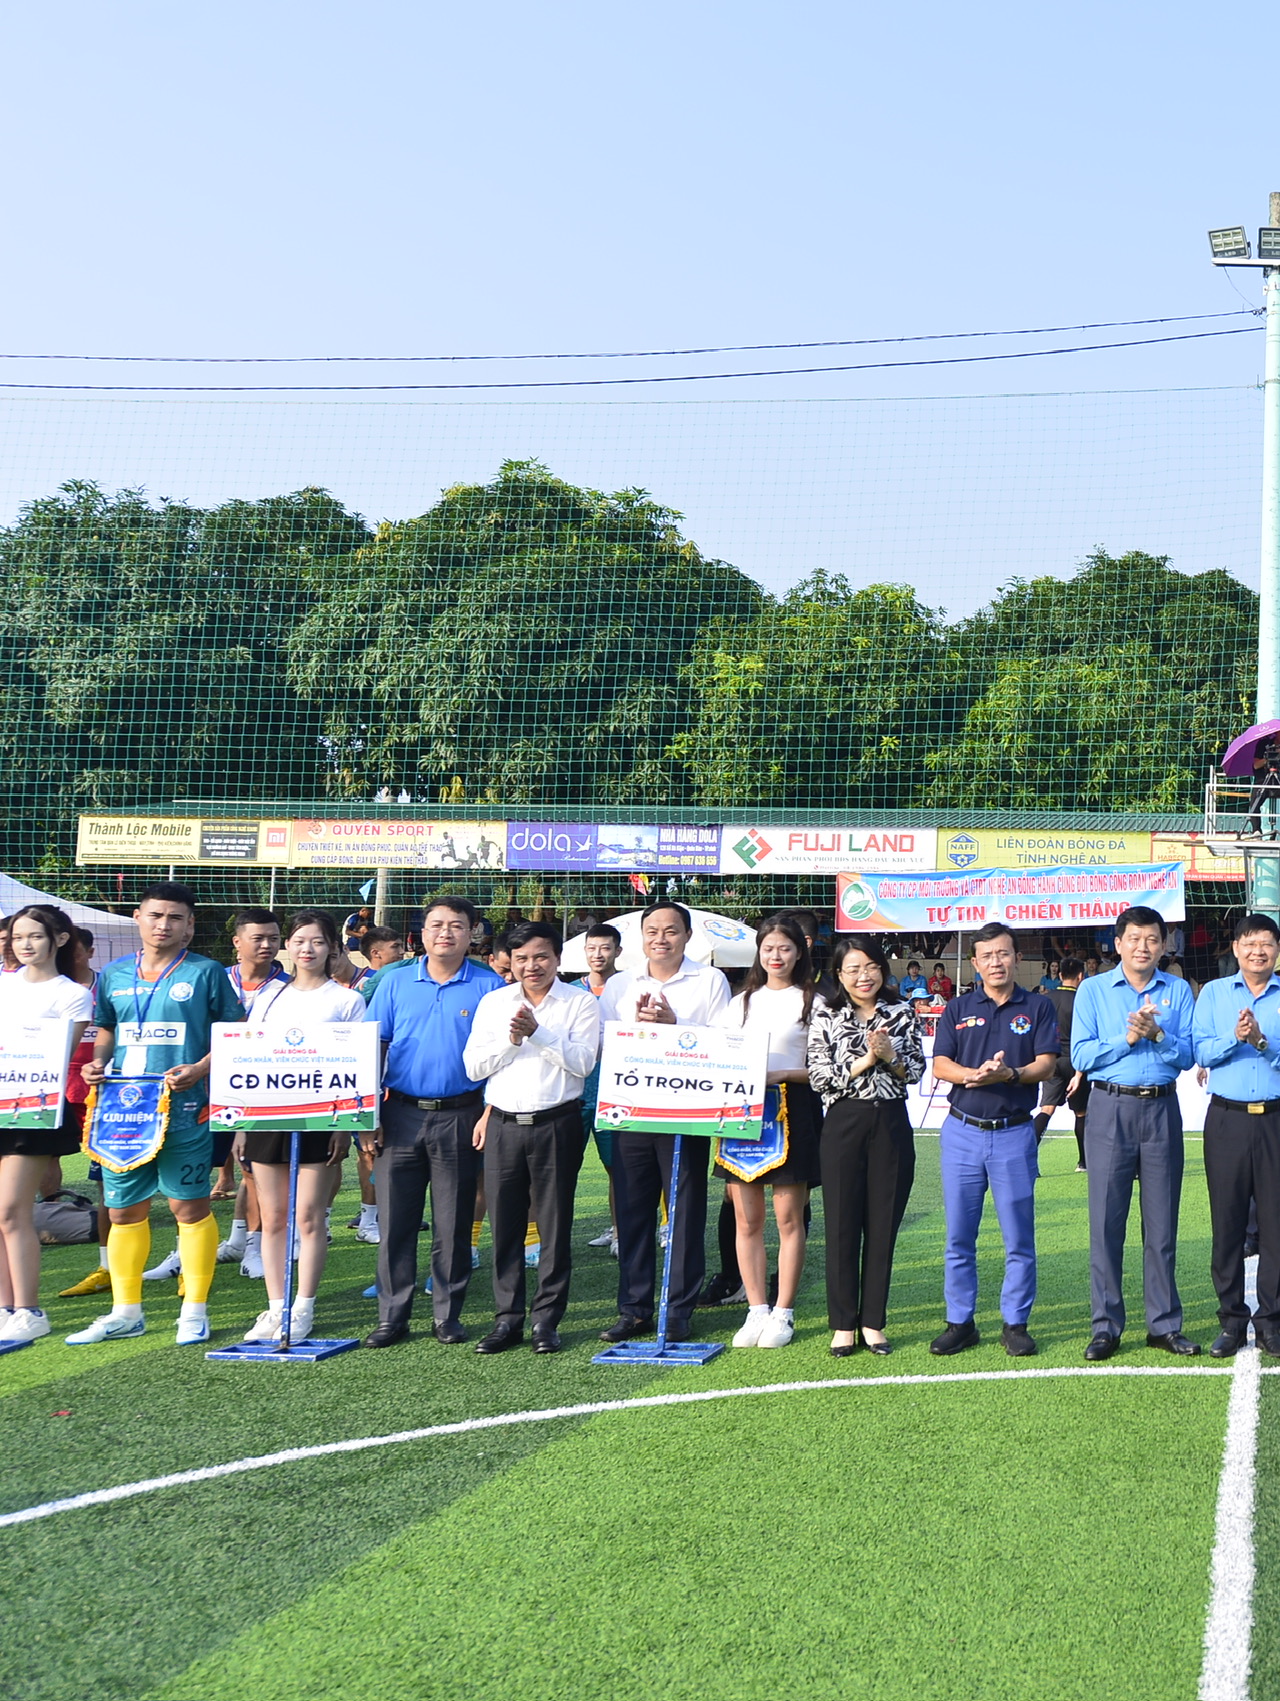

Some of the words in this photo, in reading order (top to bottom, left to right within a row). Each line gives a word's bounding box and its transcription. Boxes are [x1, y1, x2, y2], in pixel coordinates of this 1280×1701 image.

[89, 823, 123, 835] Thành
[126, 823, 148, 838] Lộc
[151, 823, 192, 836] Mobile
[387, 825, 434, 836] SPORT
[660, 826, 676, 843] NHÀ
[676, 826, 698, 843] HÀNG
[698, 829, 718, 843] DOLA
[511, 827, 571, 852] dola
[788, 833, 842, 852] FUJI
[848, 834, 914, 852] LAND
[996, 836, 1023, 849] LIÊN
[1027, 836, 1065, 850] ĐOÀN
[1067, 837, 1106, 850] BÓNG
[1108, 837, 1126, 850] ĐÁ
[950, 843, 975, 851] NAFF
[1088, 855, 1107, 865] AN
[879, 878, 897, 898] CÔNG
[899, 881, 907, 898] TY
[908, 881, 917, 898] CP
[988, 874, 1006, 899] NGHỆ
[1007, 877, 1017, 894] AN
[1037, 872, 1056, 894] HÀNH
[1057, 871, 1075, 893] CÙNG
[1077, 871, 1088, 896] ĐỘI
[1090, 871, 1108, 893] BÓNG
[1109, 870, 1127, 892] CÔNG
[1129, 869, 1147, 891] ĐOÀN
[1148, 868, 1166, 894] NGHỆ
[1167, 871, 1178, 890] AN
[926, 905, 952, 926] TỰ
[955, 906, 986, 922] TIN
[1005, 898, 1062, 920] CHIẾN
[125, 1028, 178, 1039] THACO
[233, 1056, 253, 1064] CÔNG
[311, 1056, 324, 1064] VIỆT
[624, 1056, 644, 1064] CÔNG
[702, 1061, 716, 1069] VIỆT
[30, 1070, 60, 1083] DÂN
[229, 1073, 260, 1089] CĐ
[266, 1070, 323, 1094] NGHỆ
[328, 1073, 357, 1089] AN
[614, 1068, 639, 1087] TỔ
[644, 1075, 714, 1094] TRỌNG
[722, 1080, 755, 1096] TÀI
[125, 1111, 154, 1125] NIỆM
[180, 1163, 206, 1186] 22
